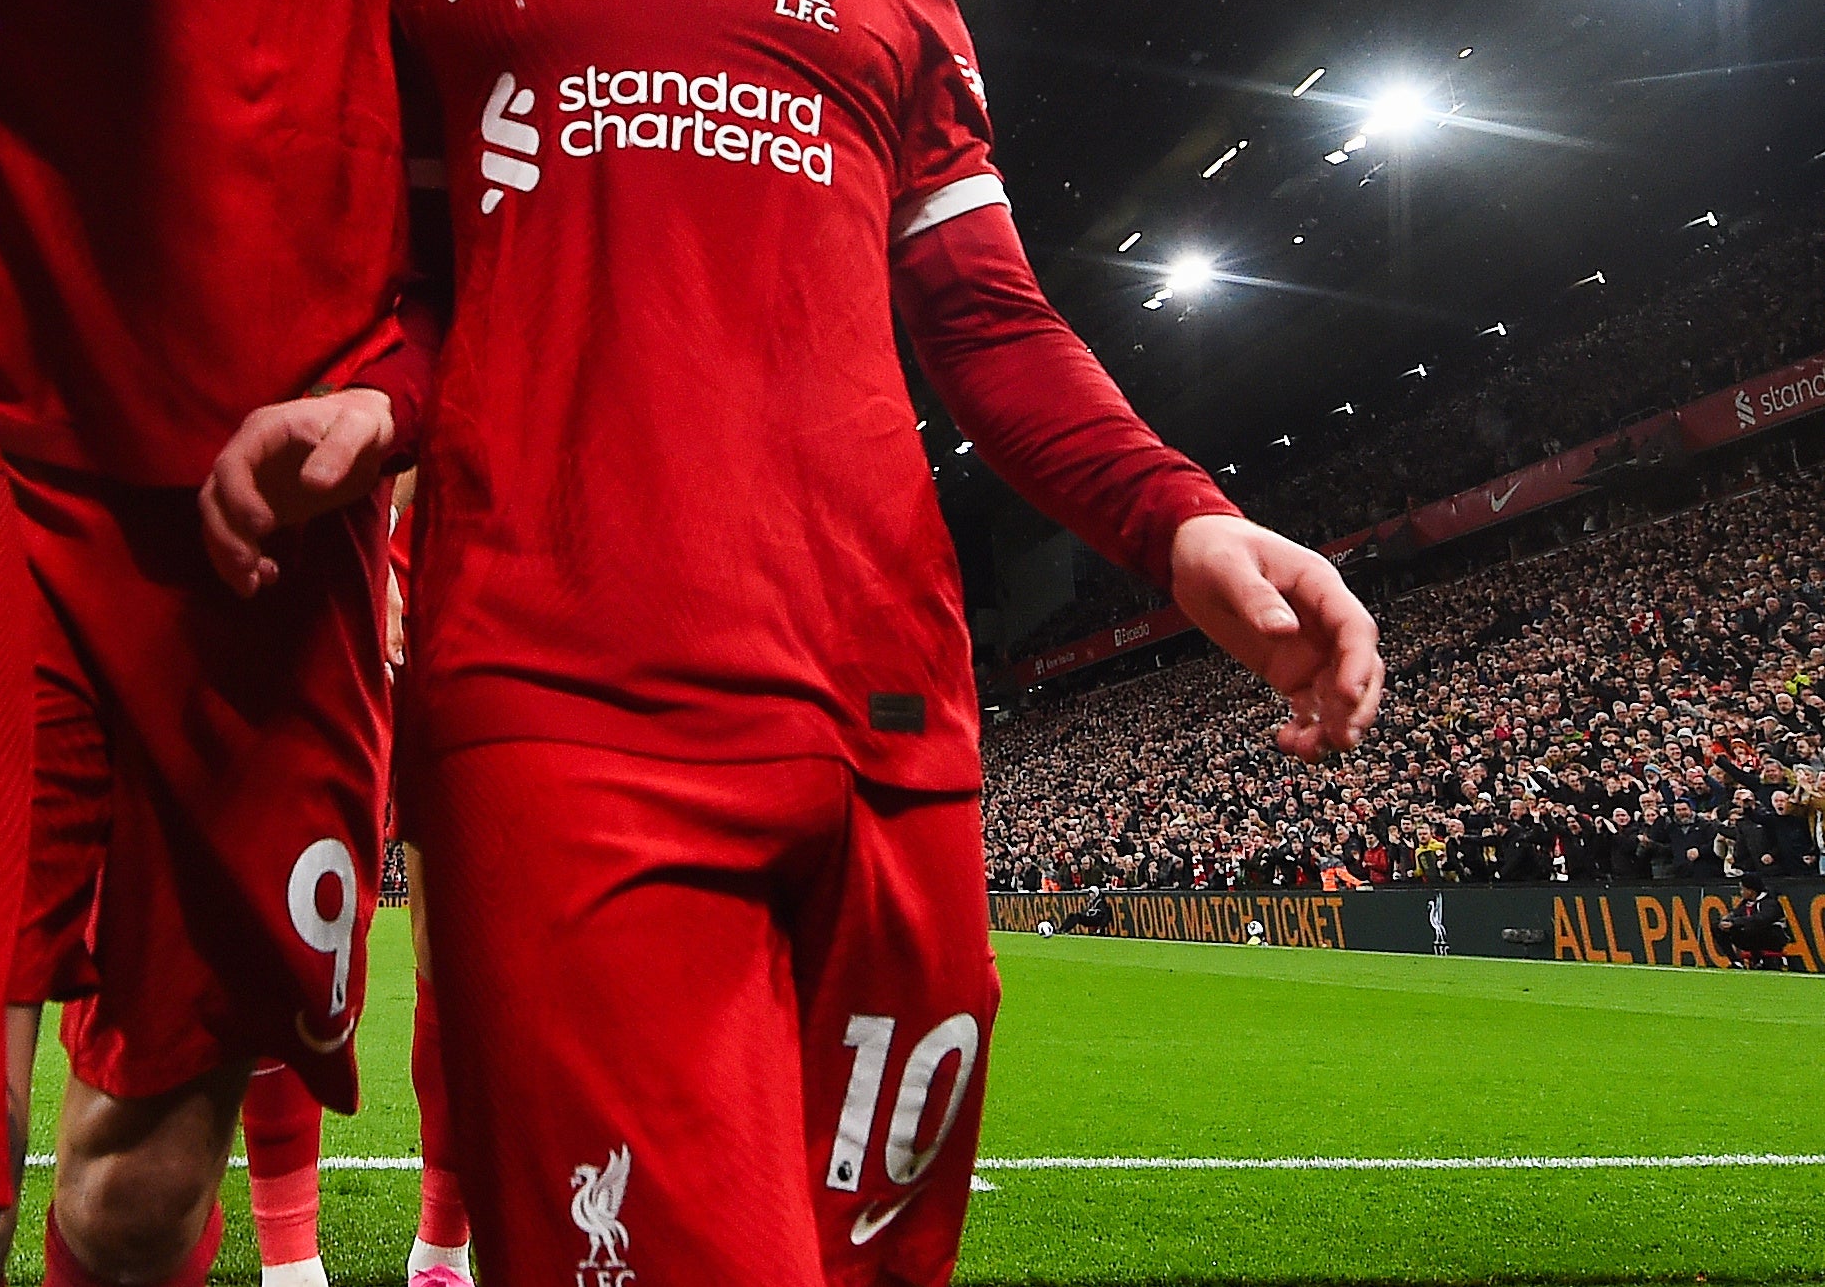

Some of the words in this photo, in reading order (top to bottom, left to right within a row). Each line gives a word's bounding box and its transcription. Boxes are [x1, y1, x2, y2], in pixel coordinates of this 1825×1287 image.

[559, 65, 823, 136] standard
[560, 110, 832, 186] chartered
[288, 838, 357, 1018] 9
[1128, 896, 1181, 940] YOUR
[1180, 896, 1254, 945] MATCH
[1256, 897, 1346, 949] TICKET
[1553, 895, 1633, 965] ALL
[826, 1012, 979, 1193] 10
